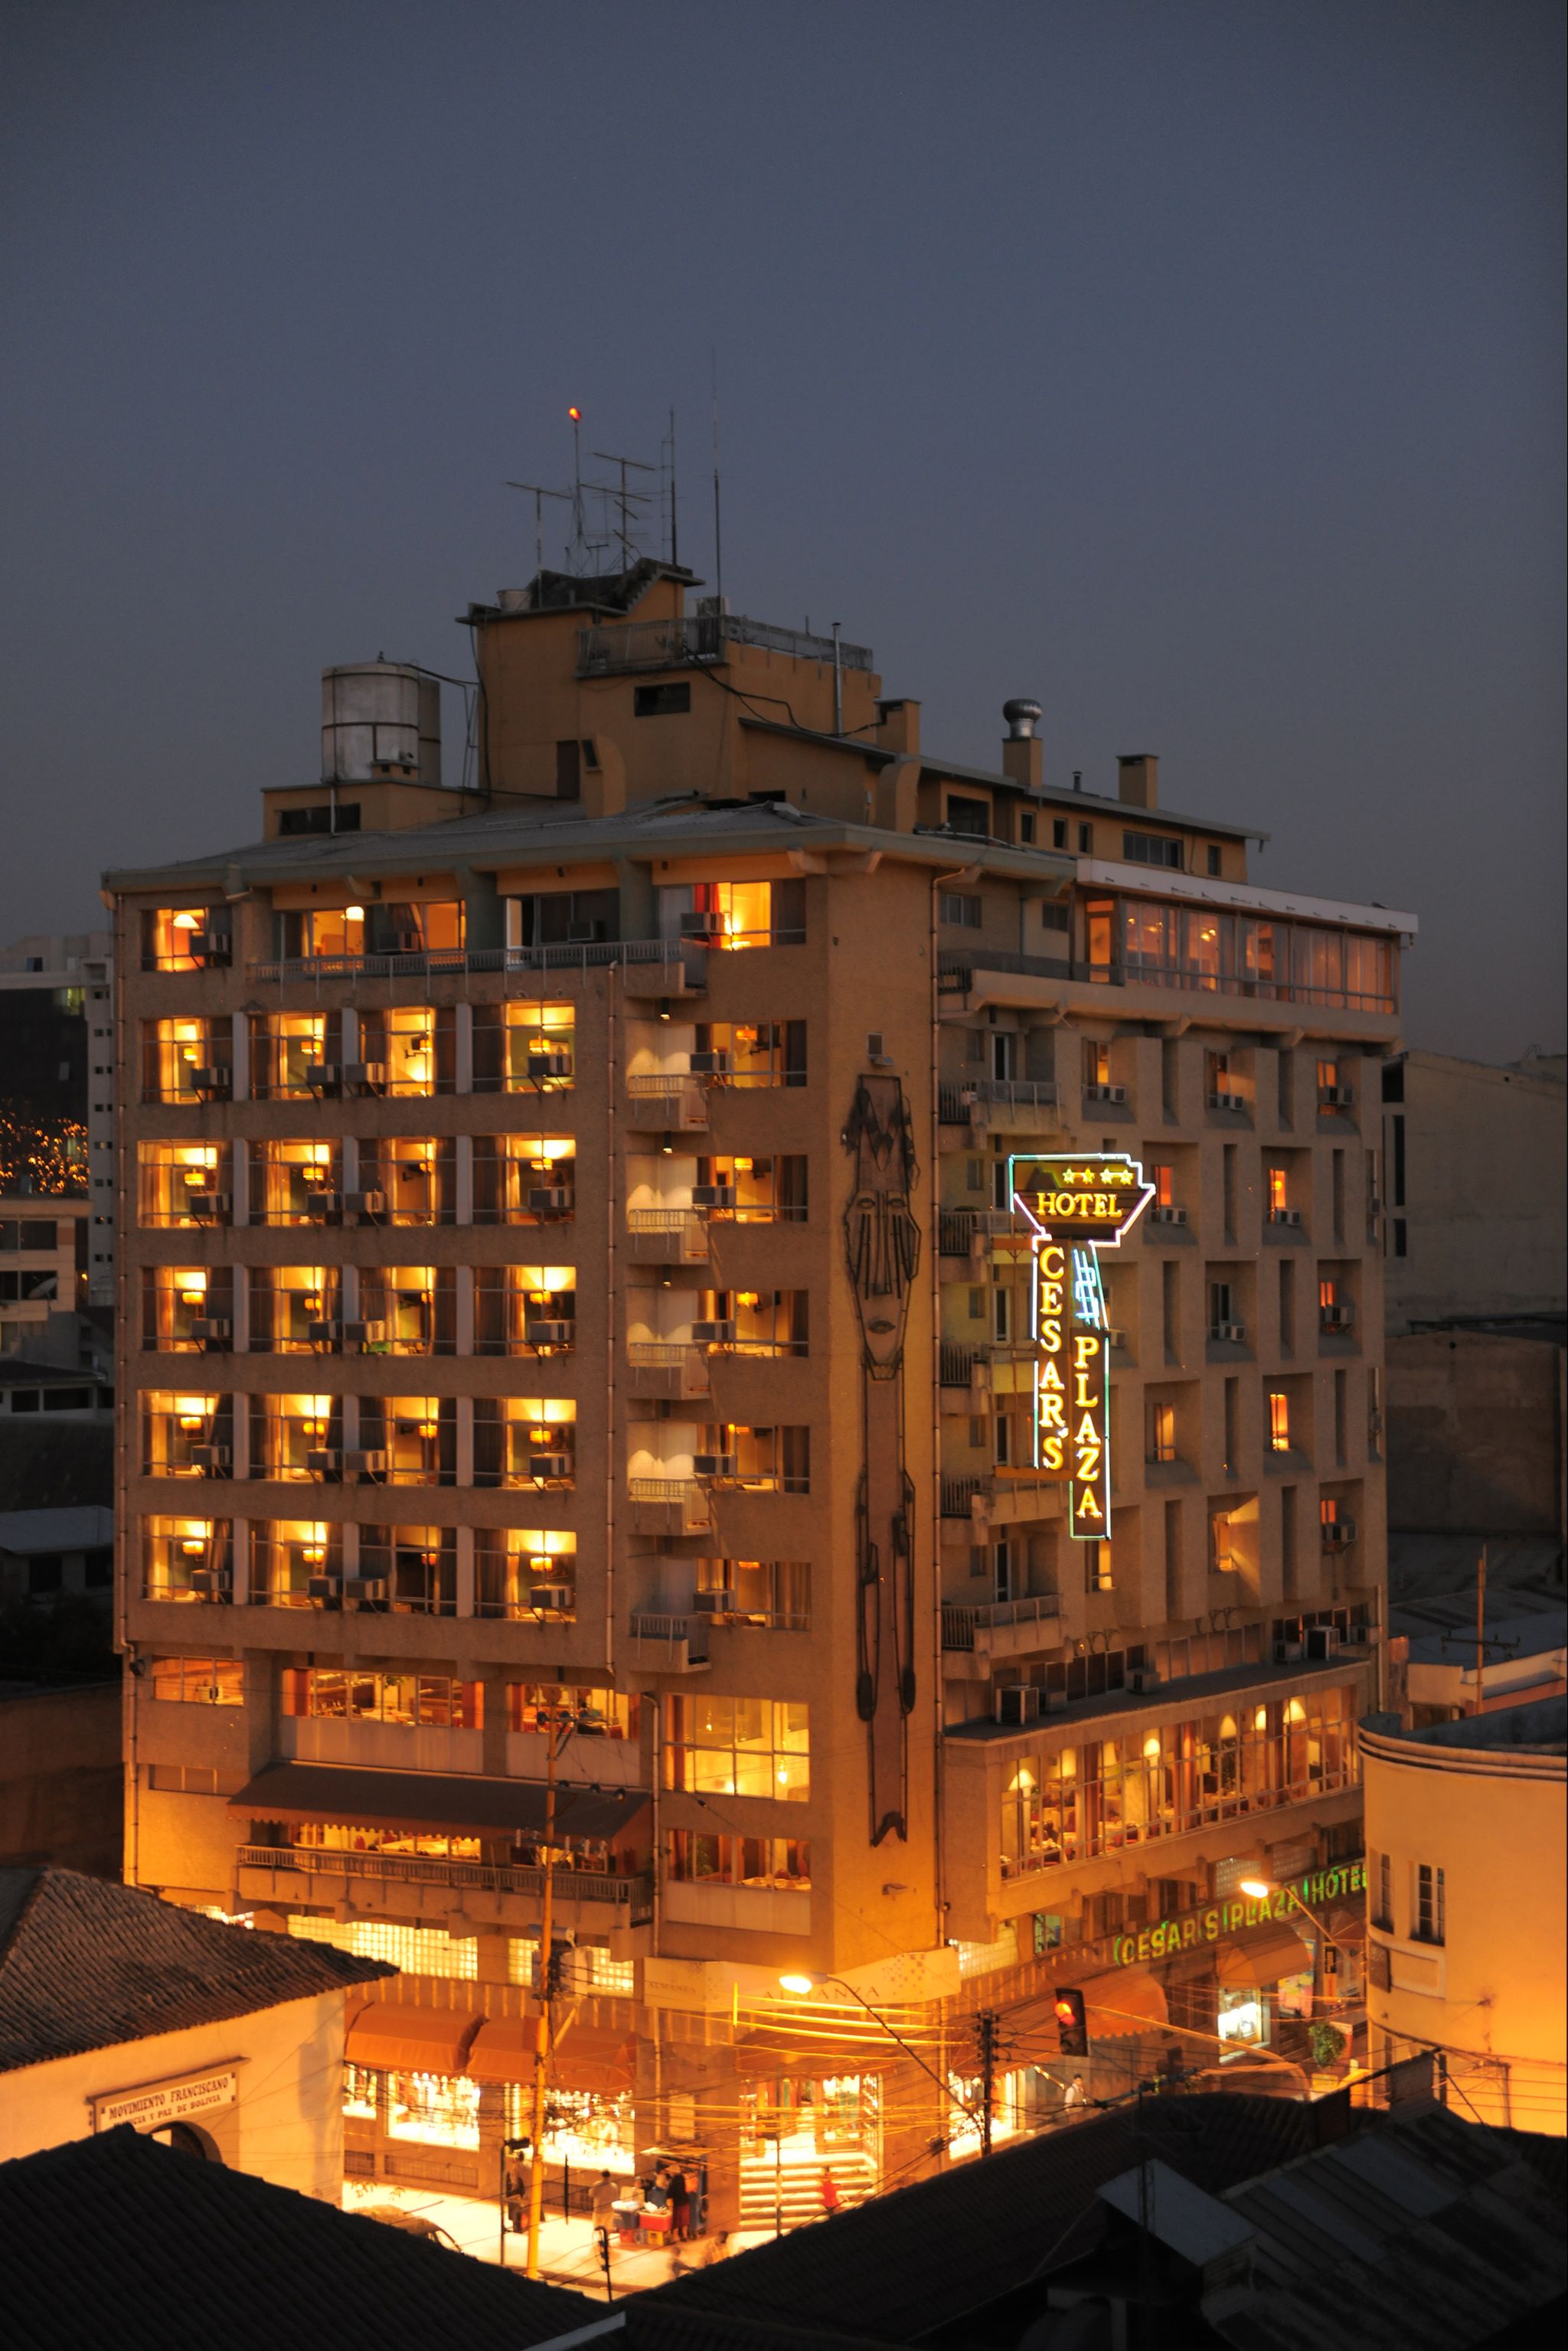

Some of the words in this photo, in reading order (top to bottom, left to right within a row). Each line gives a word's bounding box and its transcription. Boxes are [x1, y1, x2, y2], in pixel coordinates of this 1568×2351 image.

[1036, 1192, 1122, 1217] HOTEL
[1039, 1246, 1069, 1470] CESAR'S
[1074, 1335, 1102, 1519] PLAZA
[1122, 1909, 1219, 1965] CESARS
[1230, 1884, 1300, 1931] PLAZA
[109, 2093, 165, 2120] MOVIMIENTO
[171, 2076, 228, 2103] FRANCISCANO
[177, 2104, 187, 2113] DE
[190, 2094, 220, 2110] BOLIVIA
